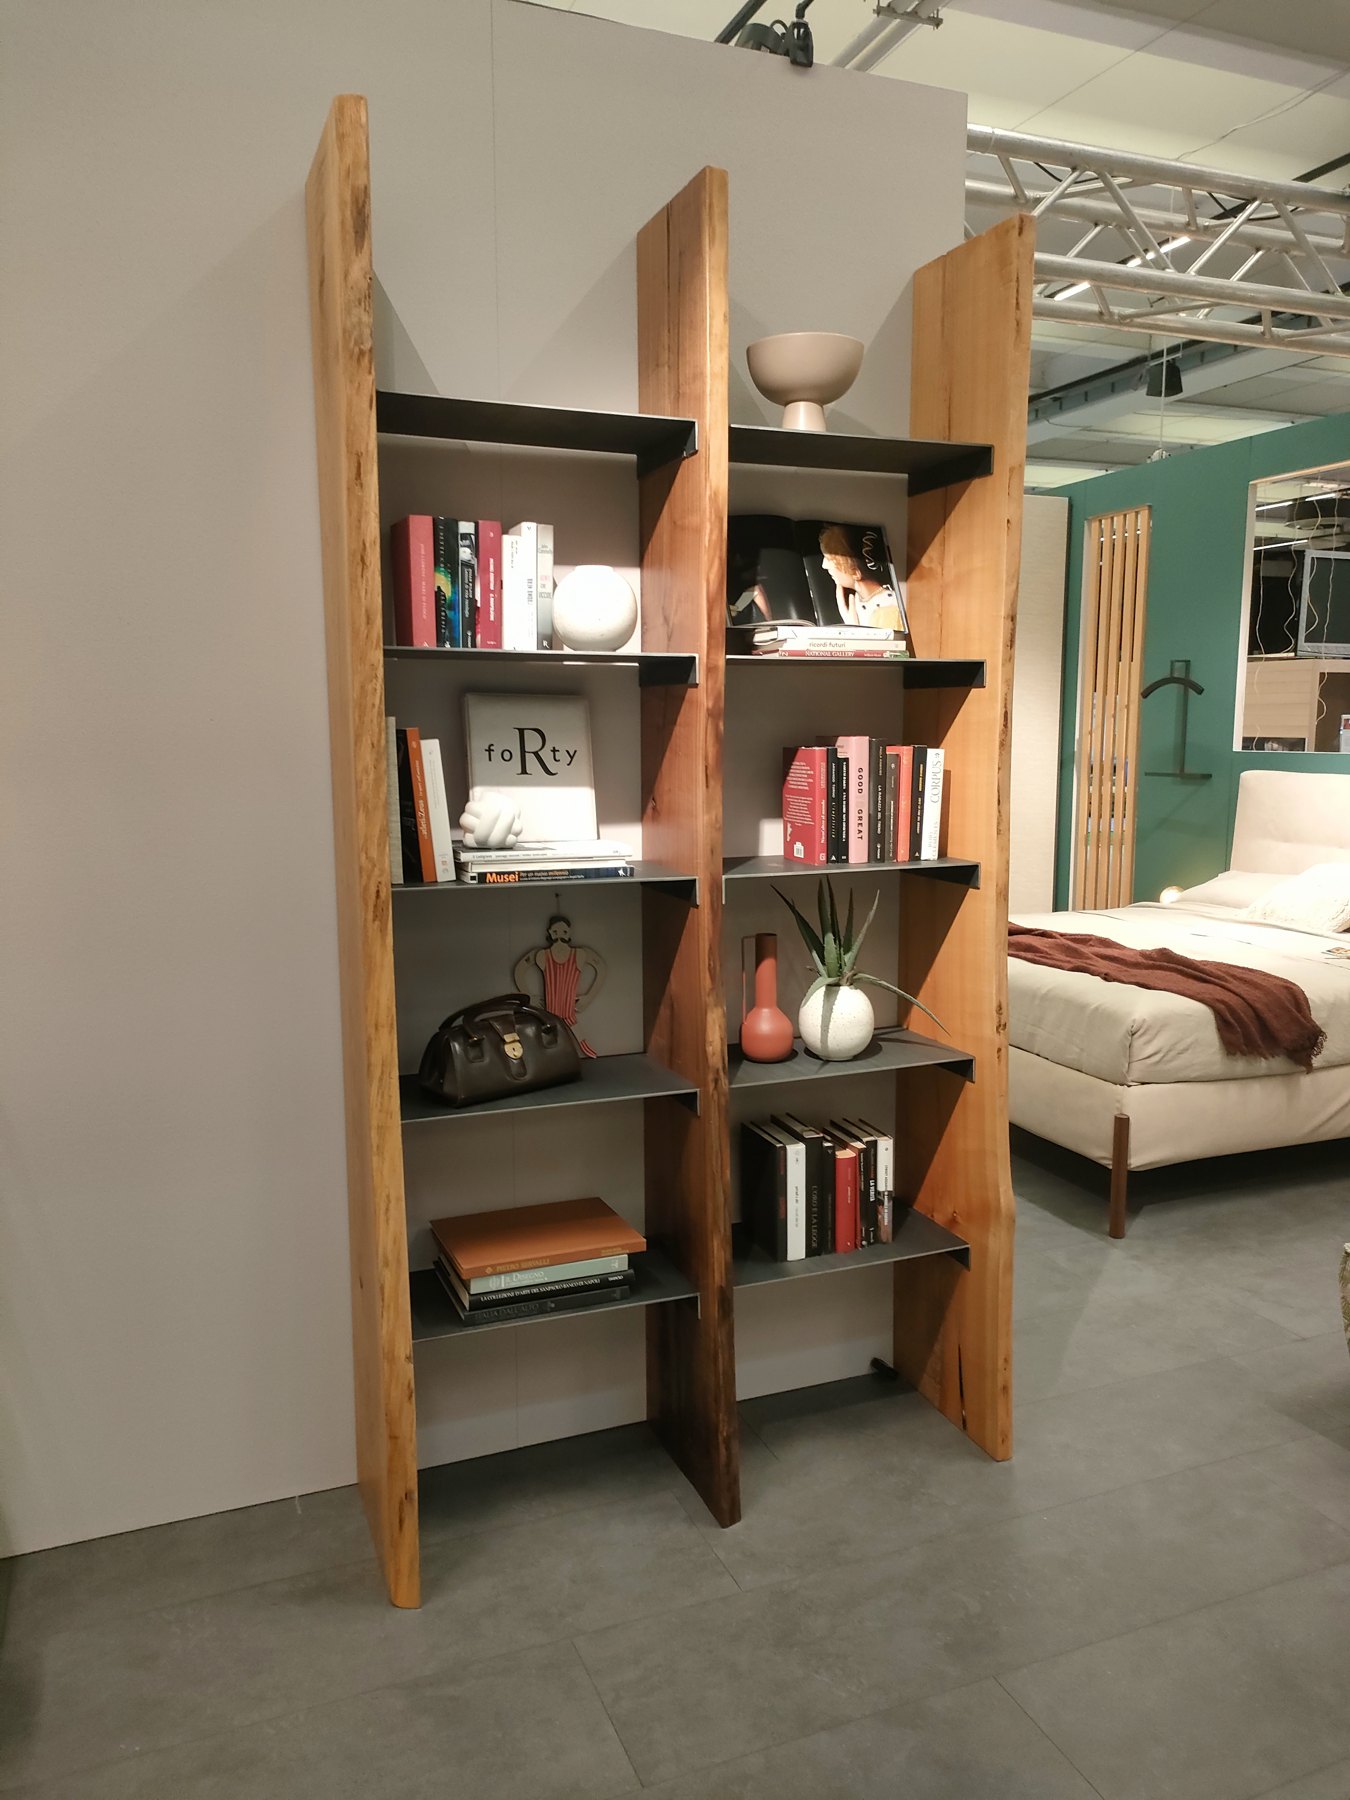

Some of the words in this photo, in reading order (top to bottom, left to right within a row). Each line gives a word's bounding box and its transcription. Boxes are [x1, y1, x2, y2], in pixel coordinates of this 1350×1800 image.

[930, 760, 942, 804] CORPUS
[856, 808, 864, 840] GREAT
[486, 872, 519, 884] Musei
